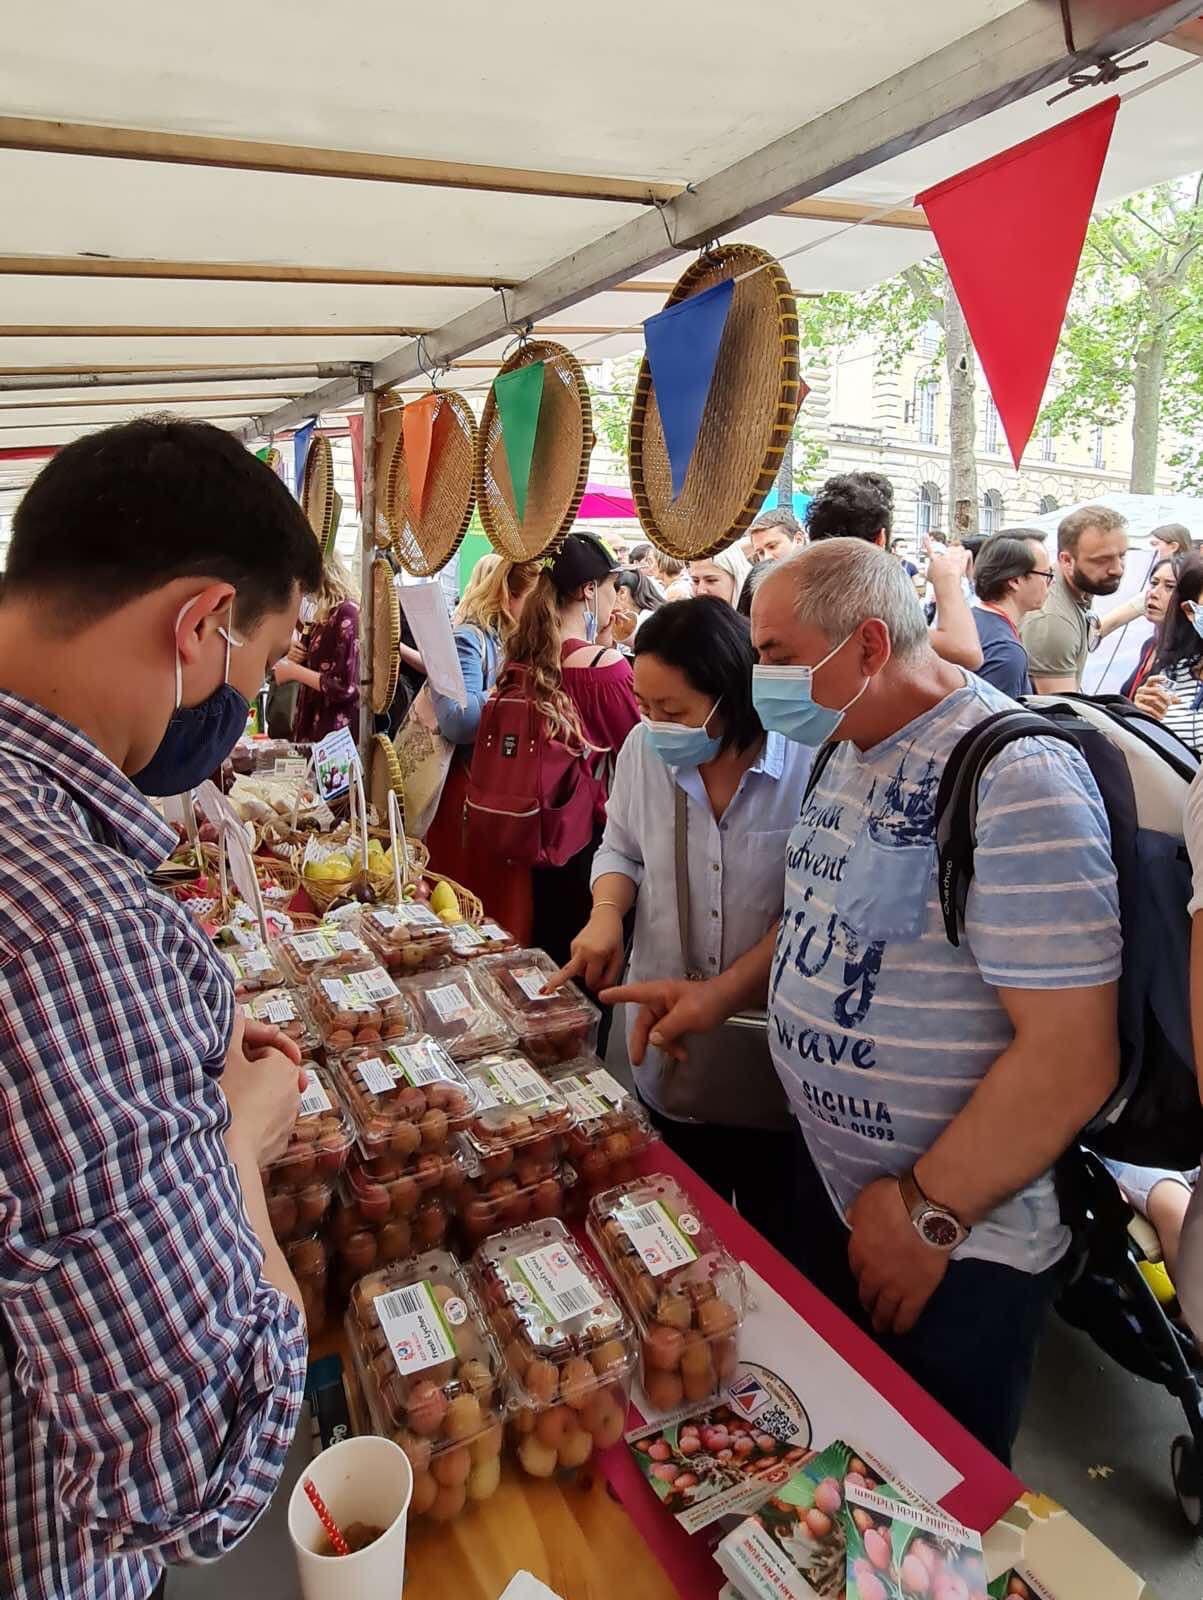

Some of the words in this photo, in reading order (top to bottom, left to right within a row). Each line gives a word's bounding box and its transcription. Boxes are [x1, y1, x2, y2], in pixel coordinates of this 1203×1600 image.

[774, 1014, 876, 1070] wave
[802, 1079, 892, 1124] SICILIA
[850, 1121, 896, 1142] 01593
